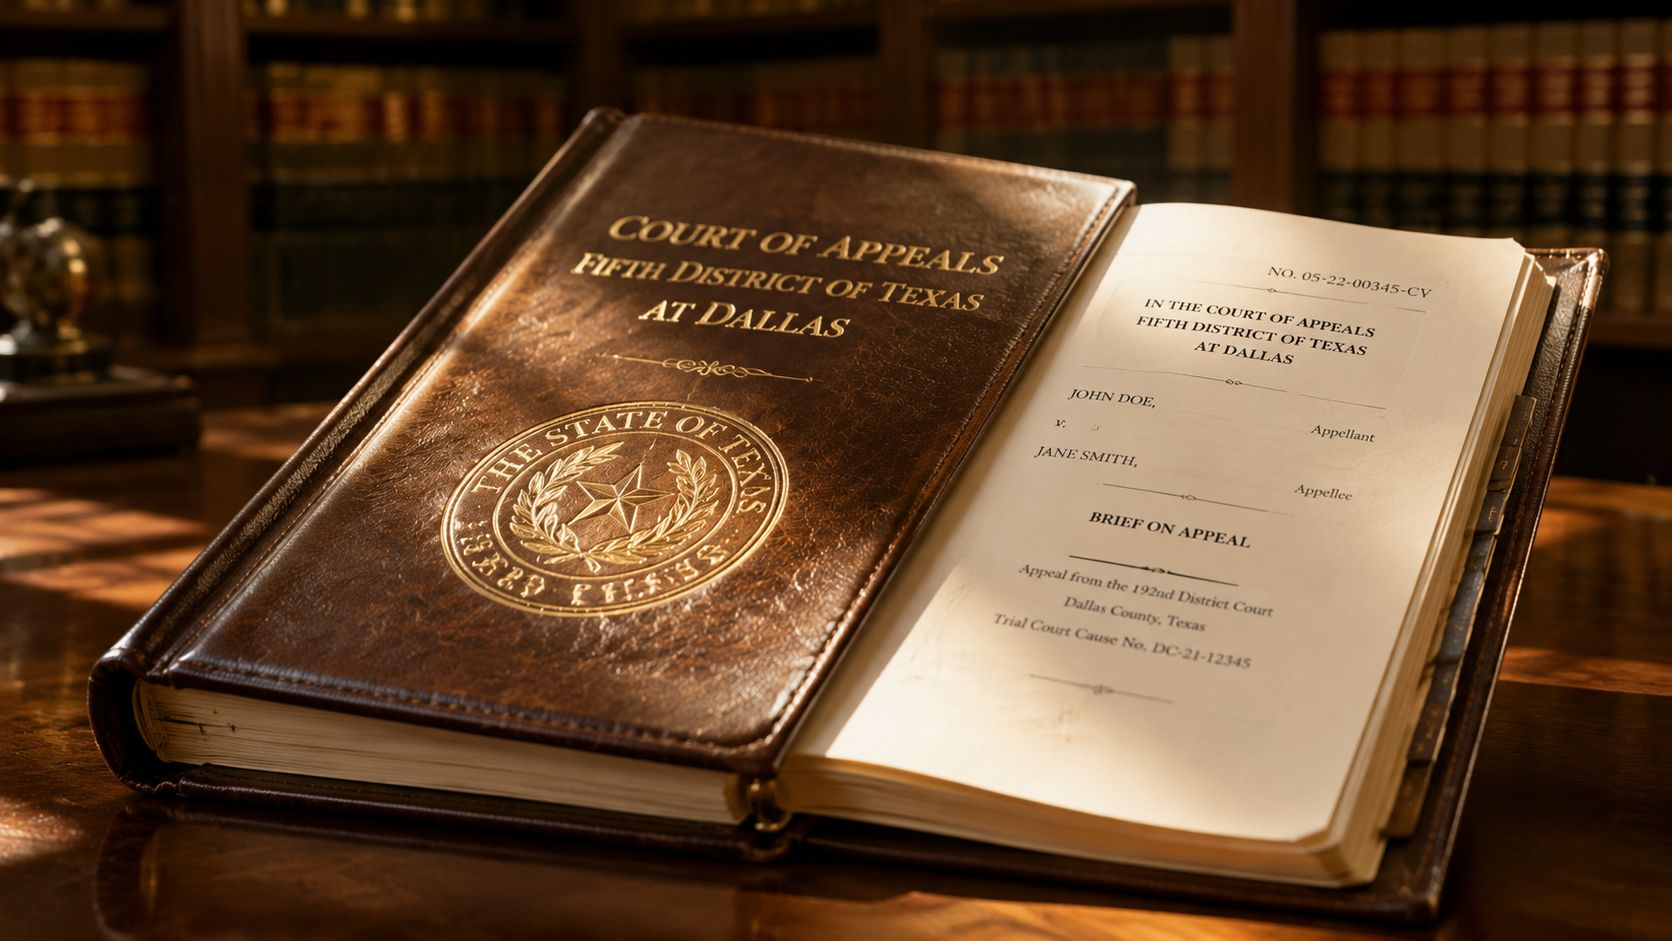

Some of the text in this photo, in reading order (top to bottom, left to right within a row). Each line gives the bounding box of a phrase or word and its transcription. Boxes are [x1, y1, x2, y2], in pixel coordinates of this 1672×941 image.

[608, 215, 1004, 276] COURT OF APPEALS
[570, 252, 984, 312] FIFTH DISTRICT OF TEXAS
[1268, 266, 1432, 299] NO. 05-22-00345-CV
[638, 300, 850, 339] AT DALLAS
[1136, 316, 1368, 356] FIFTH DISTRICT OF TEXAS
[1144, 298, 1376, 338] IN THE COURT OF APPEALS
[1194, 341, 1294, 365] AT DALLAS
[1067, 388, 1156, 408] JOHN DOE,
[1055, 419, 1066, 428] v.
[1311, 424, 1375, 443] Appellant
[471, 410, 773, 514] THE STATE OF TEXAS
[1034, 446, 1138, 468] JANE SMITH,
[1089, 512, 1251, 549] BRIEF ON APPEAL
[1019, 564, 1274, 617] Appeal from the 192nd District Court
[1064, 596, 1206, 632] Dallas County, Texas
[994, 613, 1251, 669] Trial Court Cause No. DC-21-12345
